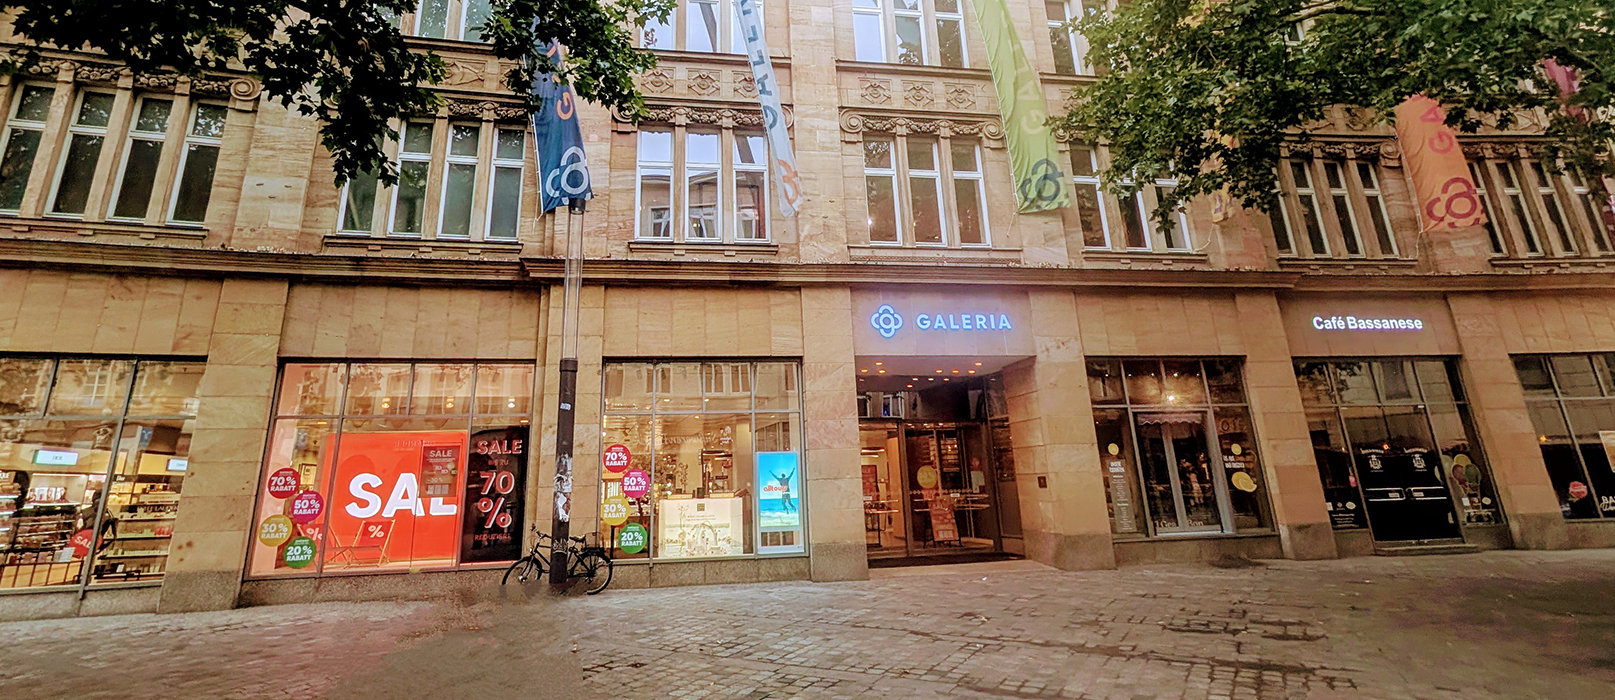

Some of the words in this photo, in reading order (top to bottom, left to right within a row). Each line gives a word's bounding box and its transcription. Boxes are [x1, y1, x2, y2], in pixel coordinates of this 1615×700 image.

[916, 313, 1012, 330] GALERIA
[1312, 316, 1346, 329] Café
[1346, 316, 1423, 329] Bassanese
[477, 439, 522, 455] SALE
[480, 470, 515, 495] 70
[477, 496, 512, 528] %
[286, 554, 312, 562] RABATT
